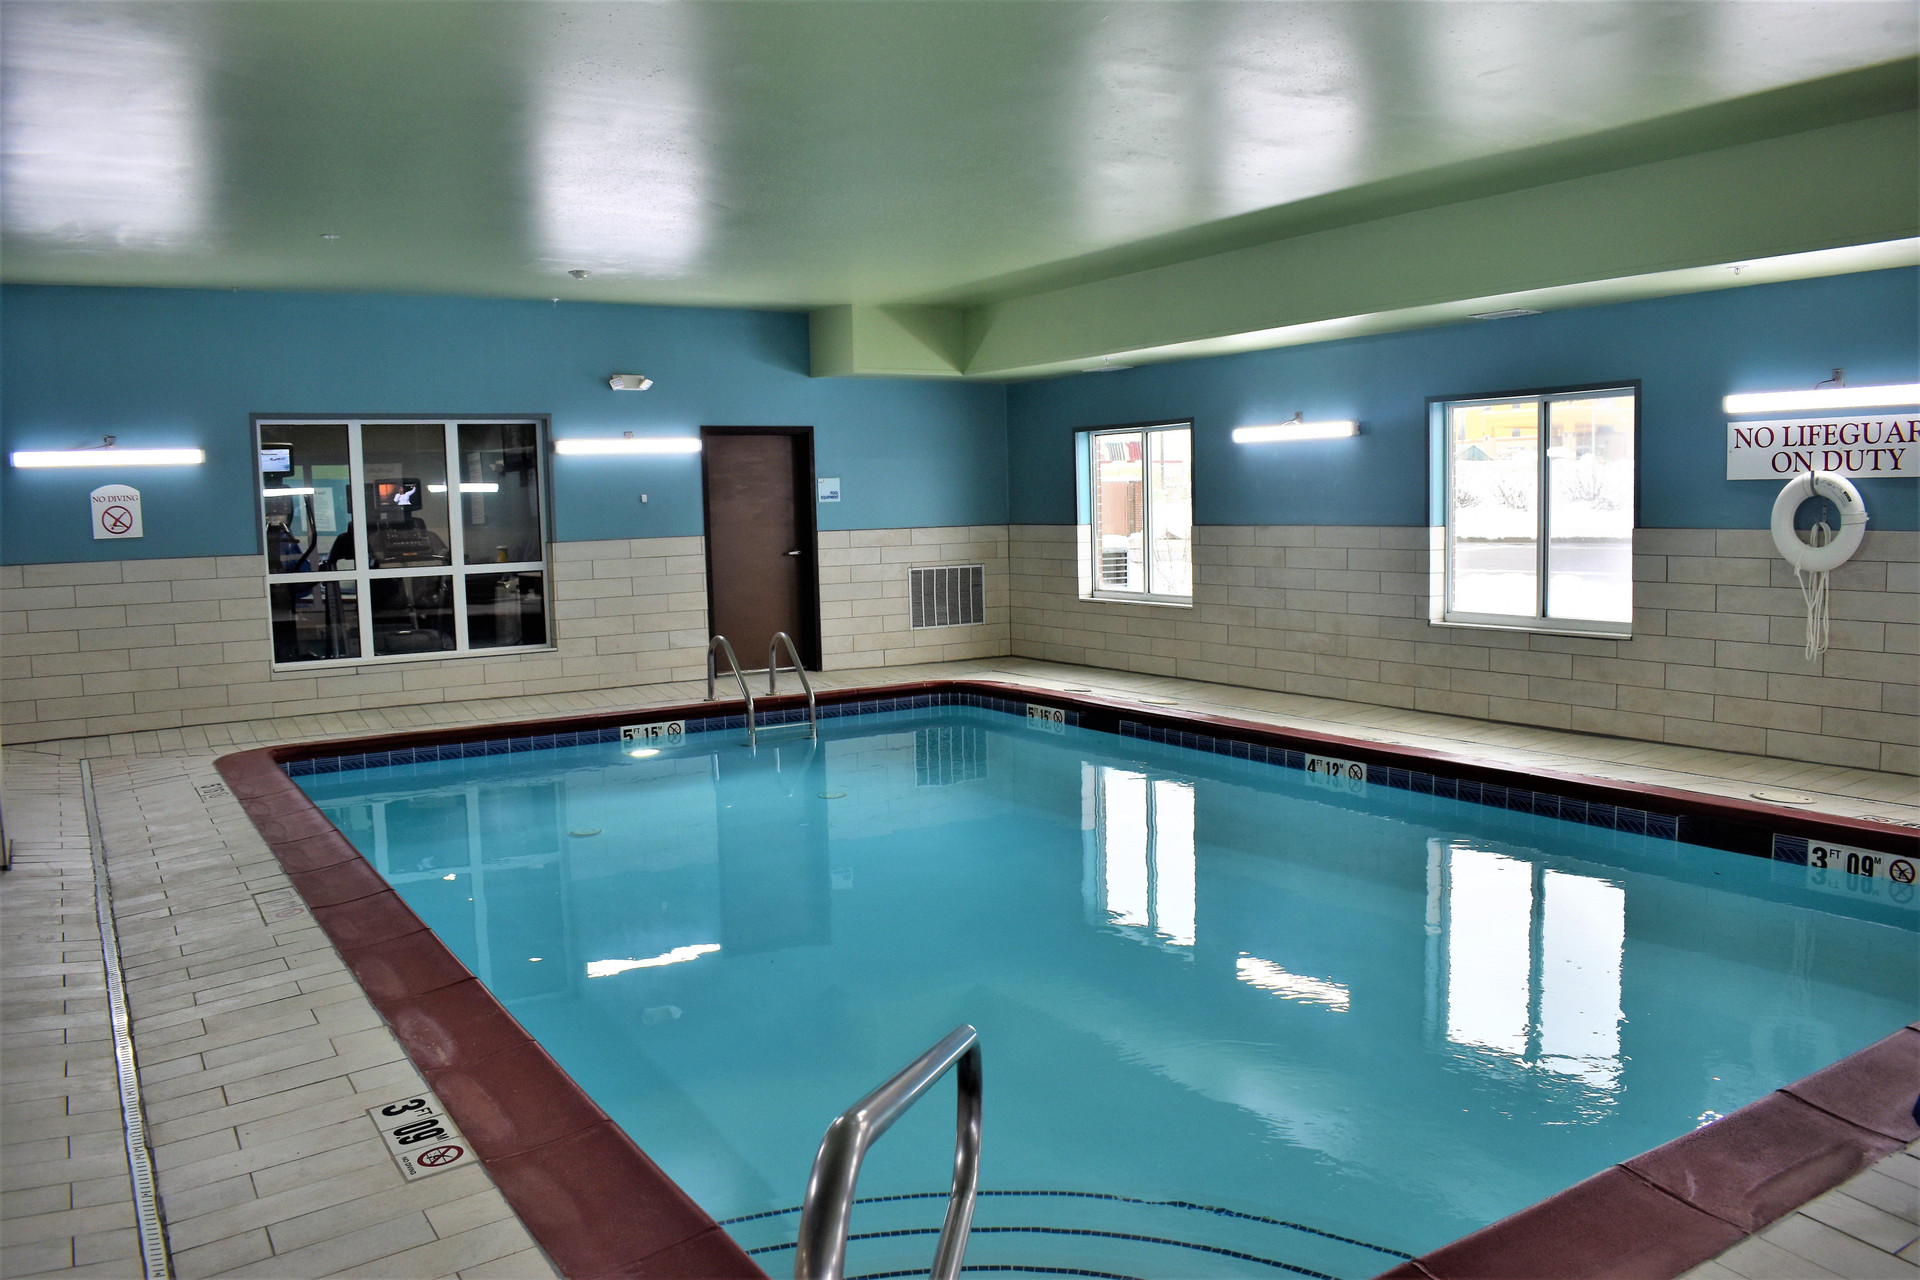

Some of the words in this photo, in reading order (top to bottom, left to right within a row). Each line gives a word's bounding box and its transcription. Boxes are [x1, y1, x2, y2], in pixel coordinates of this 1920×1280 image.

[1734, 427, 1775, 449] NO
[1771, 451, 1813, 473] ON
[1822, 448, 1906, 472] DUTY
[92, 495, 106, 503] NO
[107, 495, 139, 503] DIVING
[405, 1162, 417, 1176] DIVING
